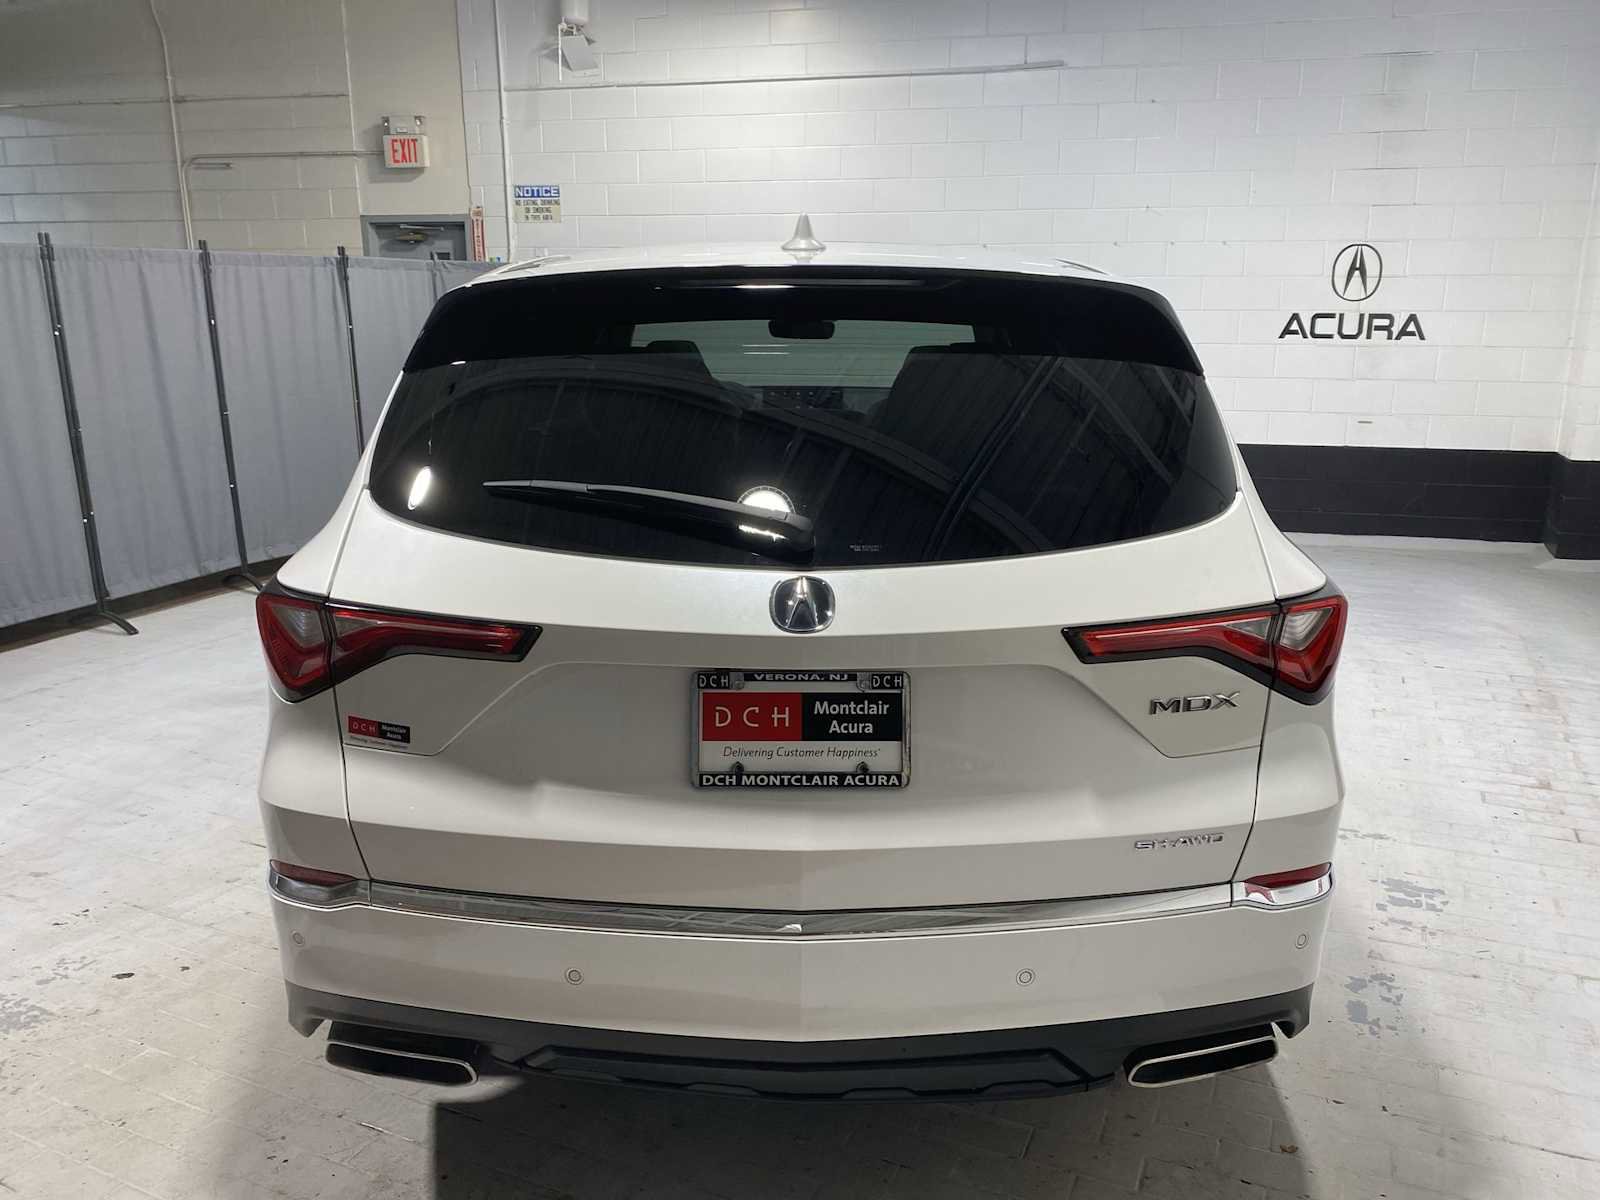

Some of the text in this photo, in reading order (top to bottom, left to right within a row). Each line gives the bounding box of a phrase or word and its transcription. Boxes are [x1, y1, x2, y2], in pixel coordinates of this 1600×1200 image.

[391, 138, 418, 164] EXIT
[515, 186, 559, 197] NOTICE
[1278, 312, 1426, 340] ACURA
[829, 673, 849, 681] NJ
[814, 700, 890, 715] Montclair
[1149, 691, 1241, 715] MDX
[829, 719, 873, 734] Acura
[723, 746, 774, 760] Delivering
[776, 746, 825, 758] Customer
[702, 774, 900, 786] DCH MONTCLAIR ACURA
